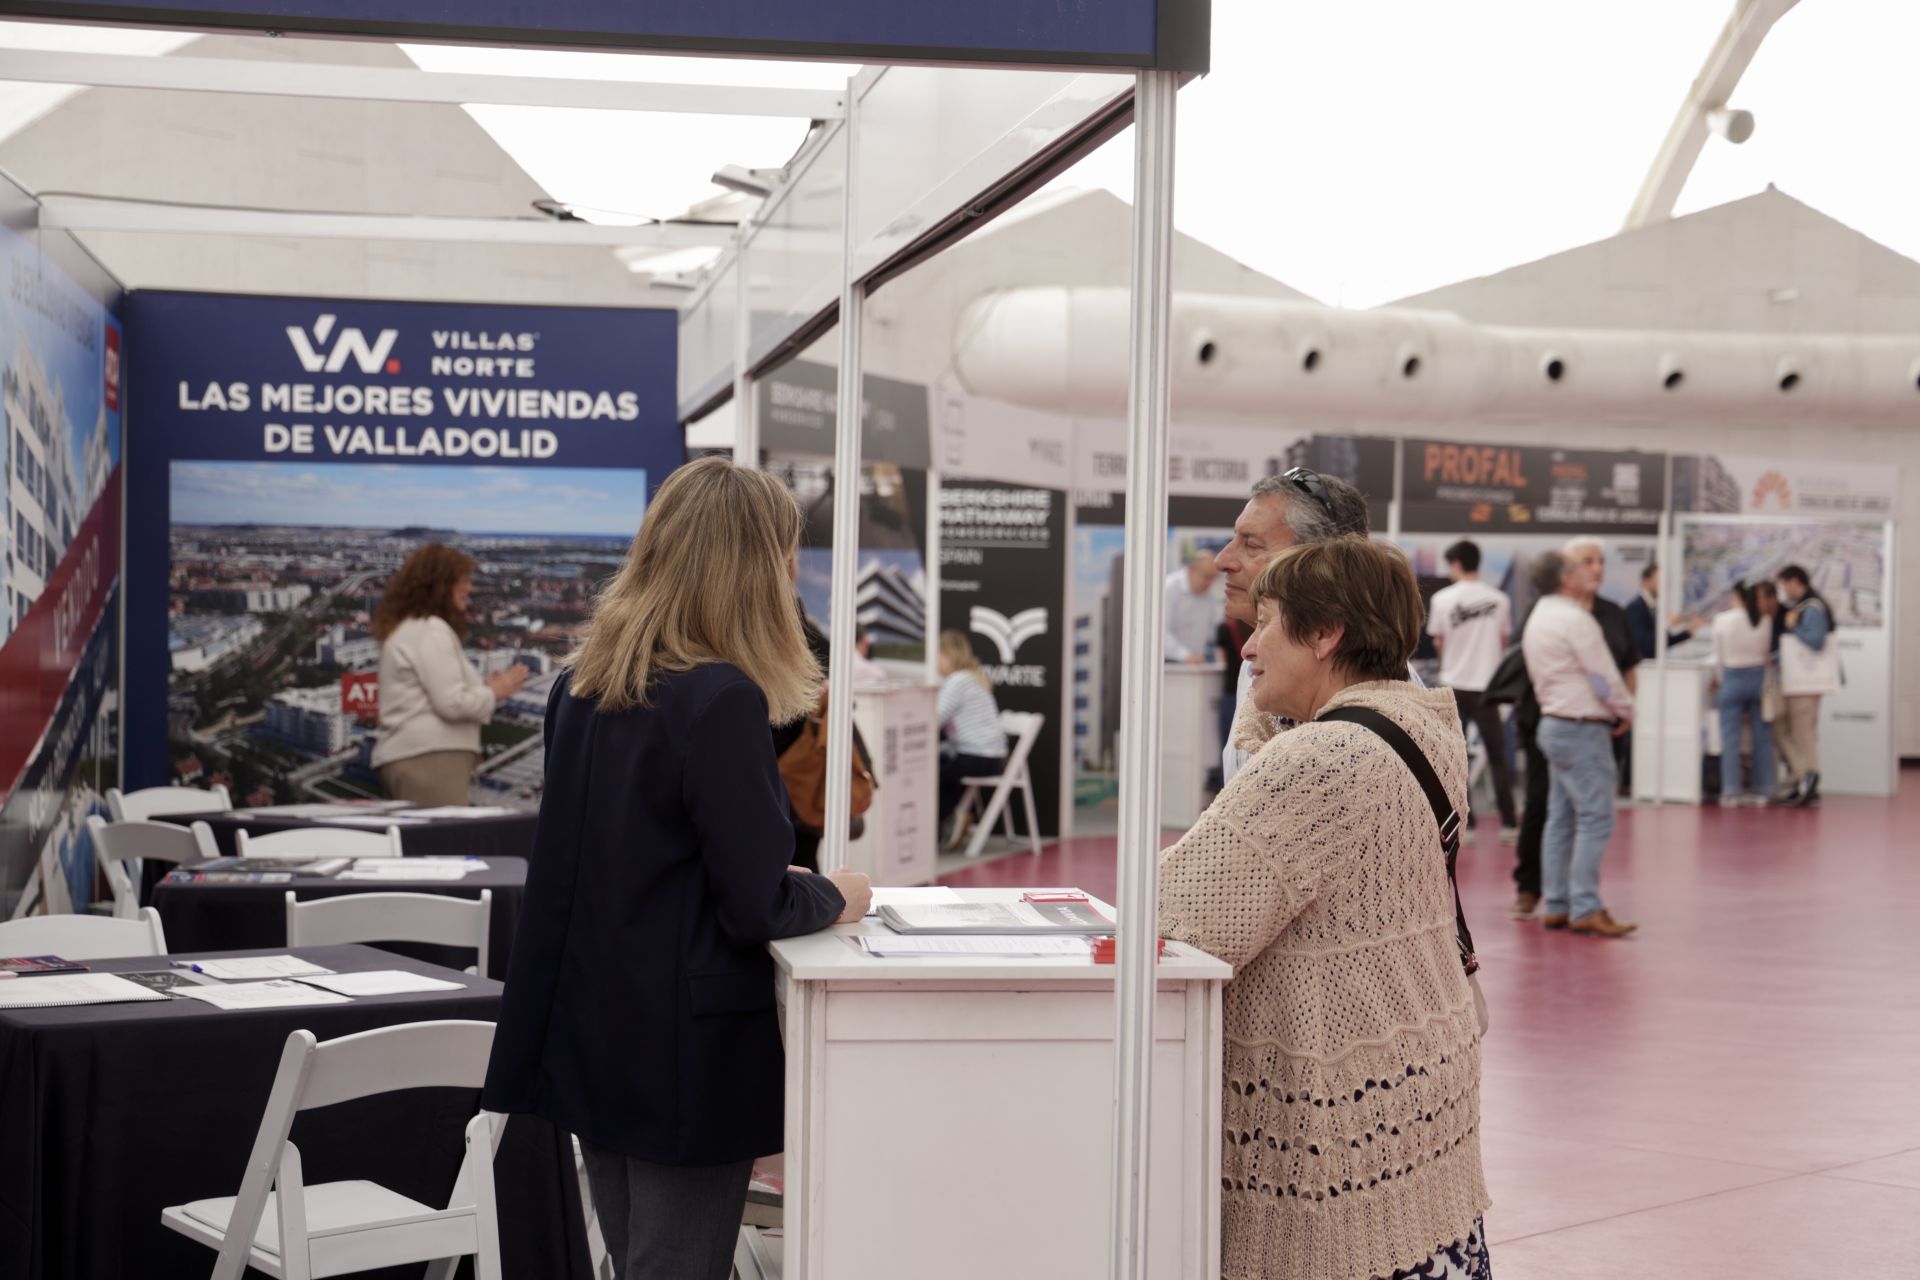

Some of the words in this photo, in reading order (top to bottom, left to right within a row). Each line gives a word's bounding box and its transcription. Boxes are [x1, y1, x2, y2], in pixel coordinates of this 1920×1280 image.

[432, 331, 535, 351] VILLAS
[432, 357, 535, 377] NORTE
[179, 381, 251, 411] LAS
[261, 383, 434, 416] MEJORES
[443, 388, 639, 420] VIVIENDAS
[264, 424, 315, 454] DE
[324, 425, 559, 459] VALLADOLID
[1424, 443, 1528, 488] PROFAL
[939, 488, 1051, 507] BERKSHIRE
[939, 508, 1050, 525] HATHAWAY
